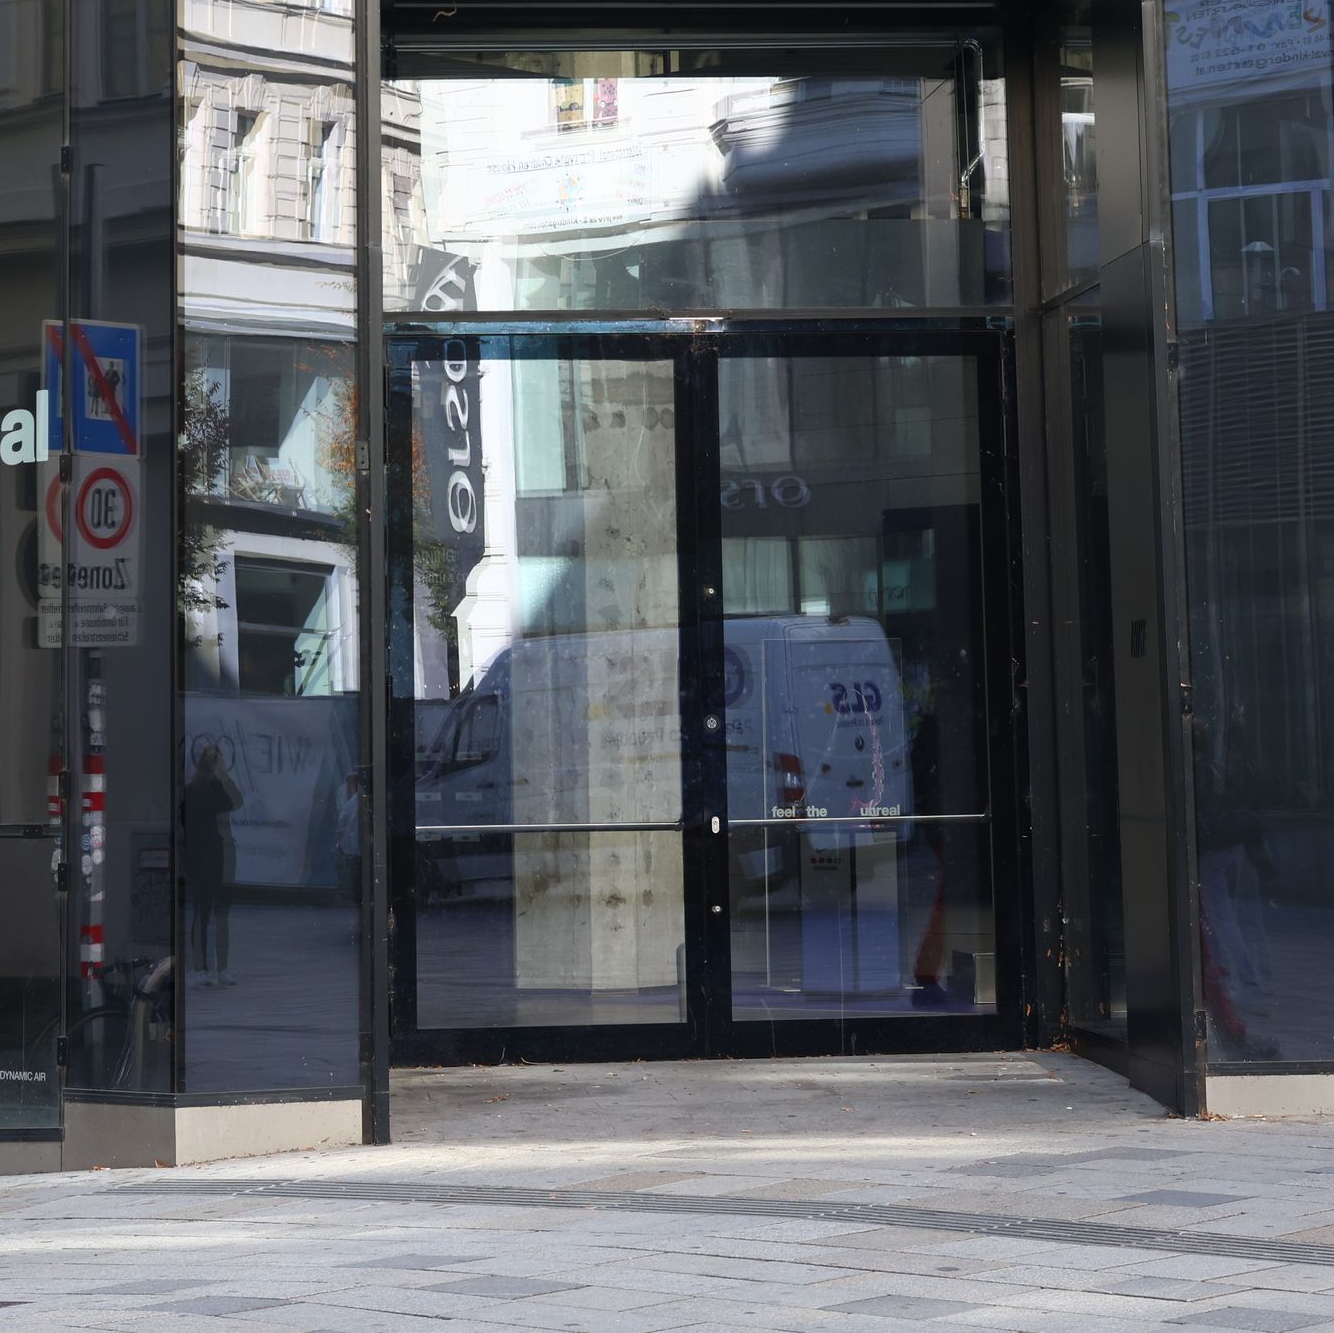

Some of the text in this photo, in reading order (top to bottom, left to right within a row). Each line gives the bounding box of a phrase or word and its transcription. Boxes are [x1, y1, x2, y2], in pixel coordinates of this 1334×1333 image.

[772, 804, 901, 818] feel the unreal
[0, 1070, 33, 1081] DYNAMIC
[33, 1071, 47, 1081] AIR
